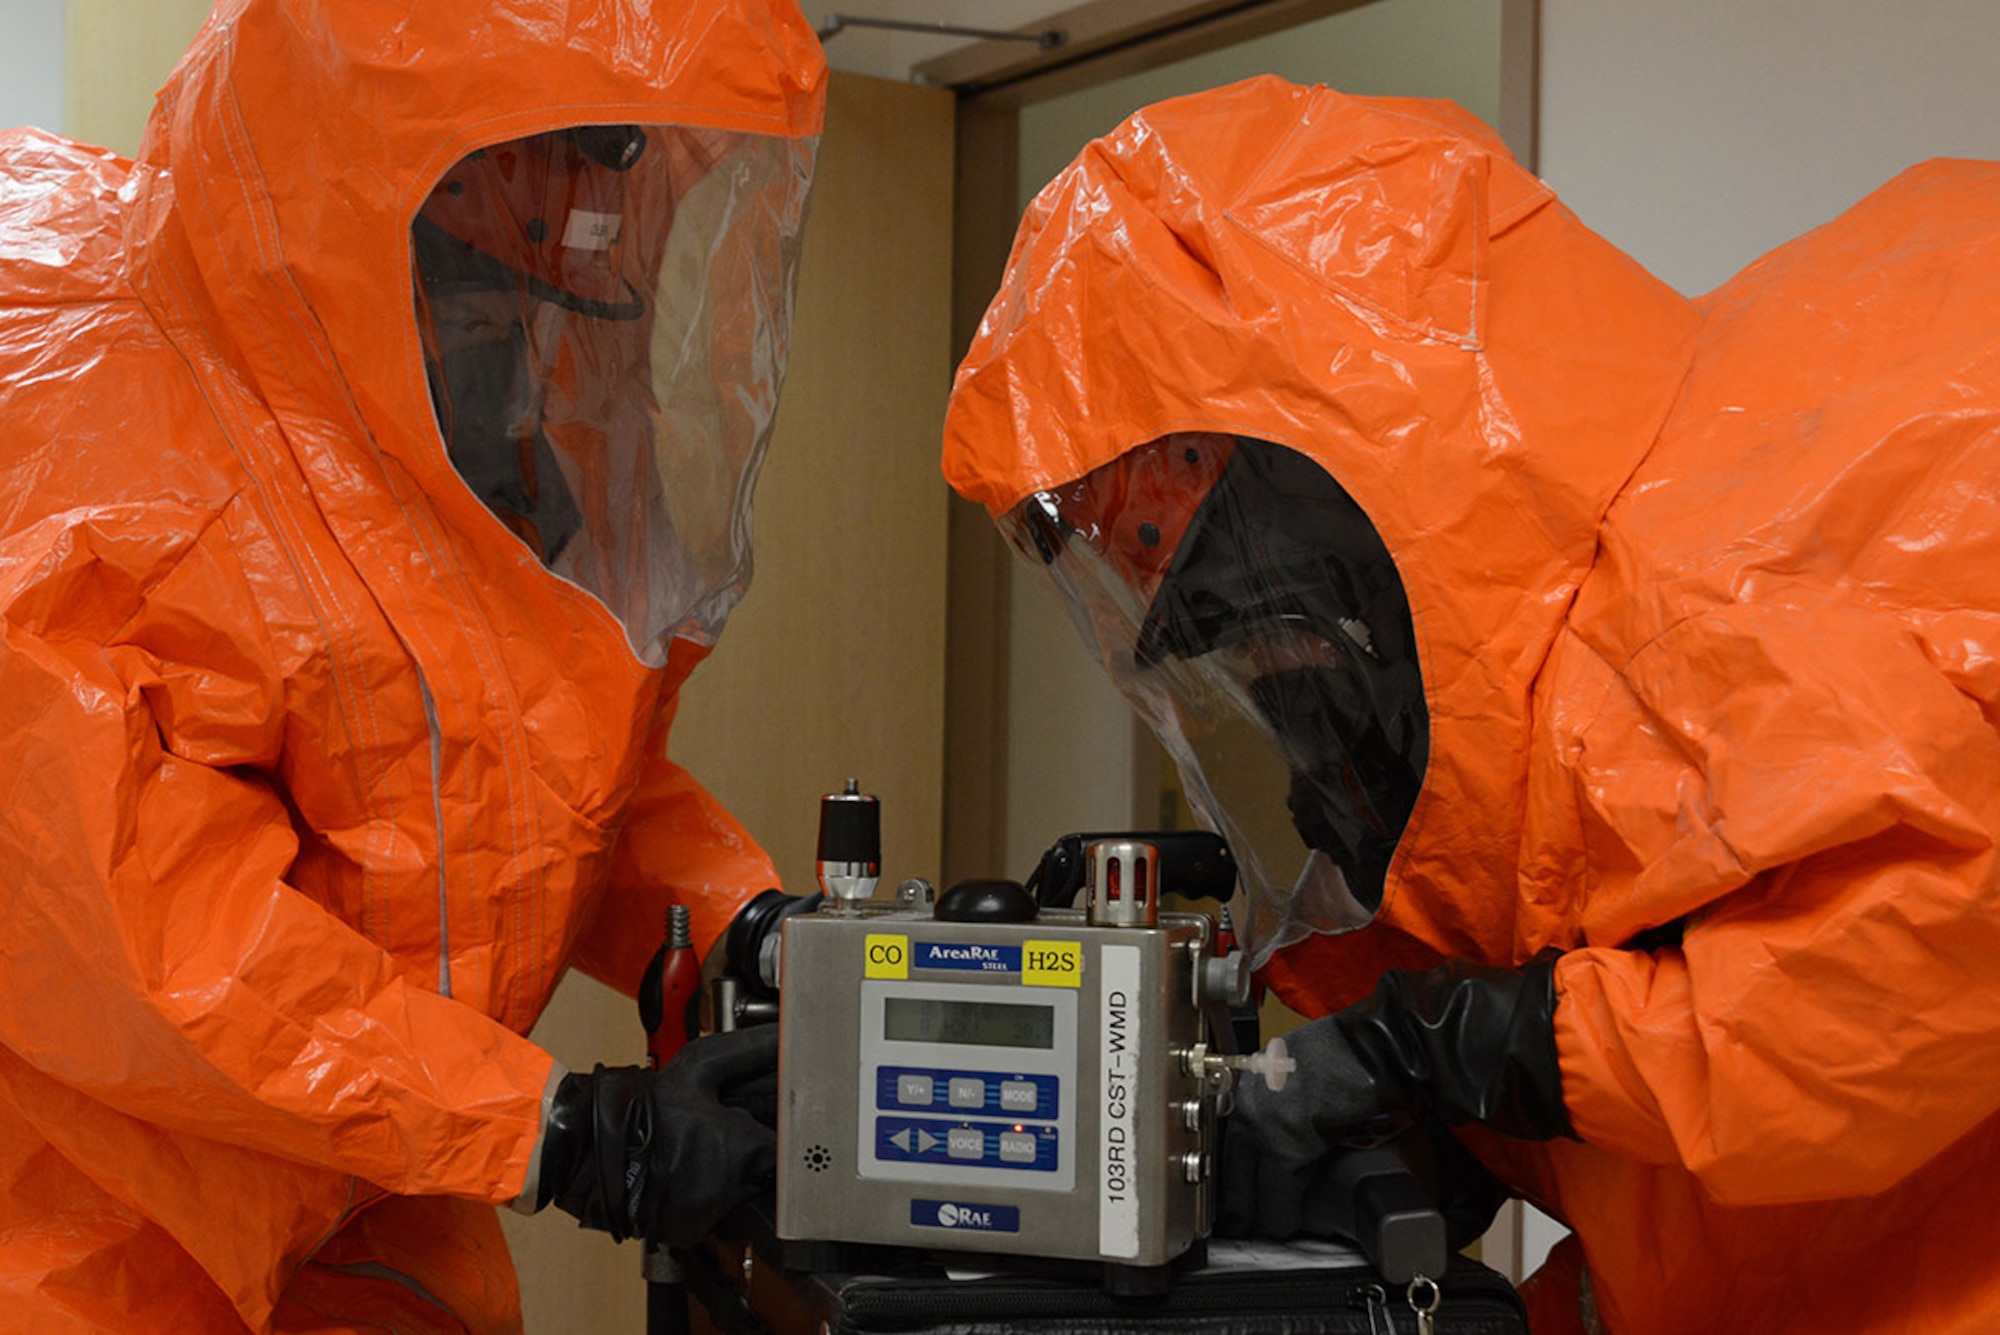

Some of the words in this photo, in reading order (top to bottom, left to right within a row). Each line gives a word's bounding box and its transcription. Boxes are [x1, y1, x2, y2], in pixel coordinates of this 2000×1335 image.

[869, 945, 902, 965] CO
[1028, 951, 1075, 972] H2S
[982, 961, 1008, 971] STEEL
[1108, 991, 1126, 1119] CST-WMD
[1004, 1088, 1034, 1102] MODE
[950, 1136, 982, 1150] VOICE
[1001, 1142, 1034, 1156] RADIO
[1108, 1126, 1125, 1204] 103RD
